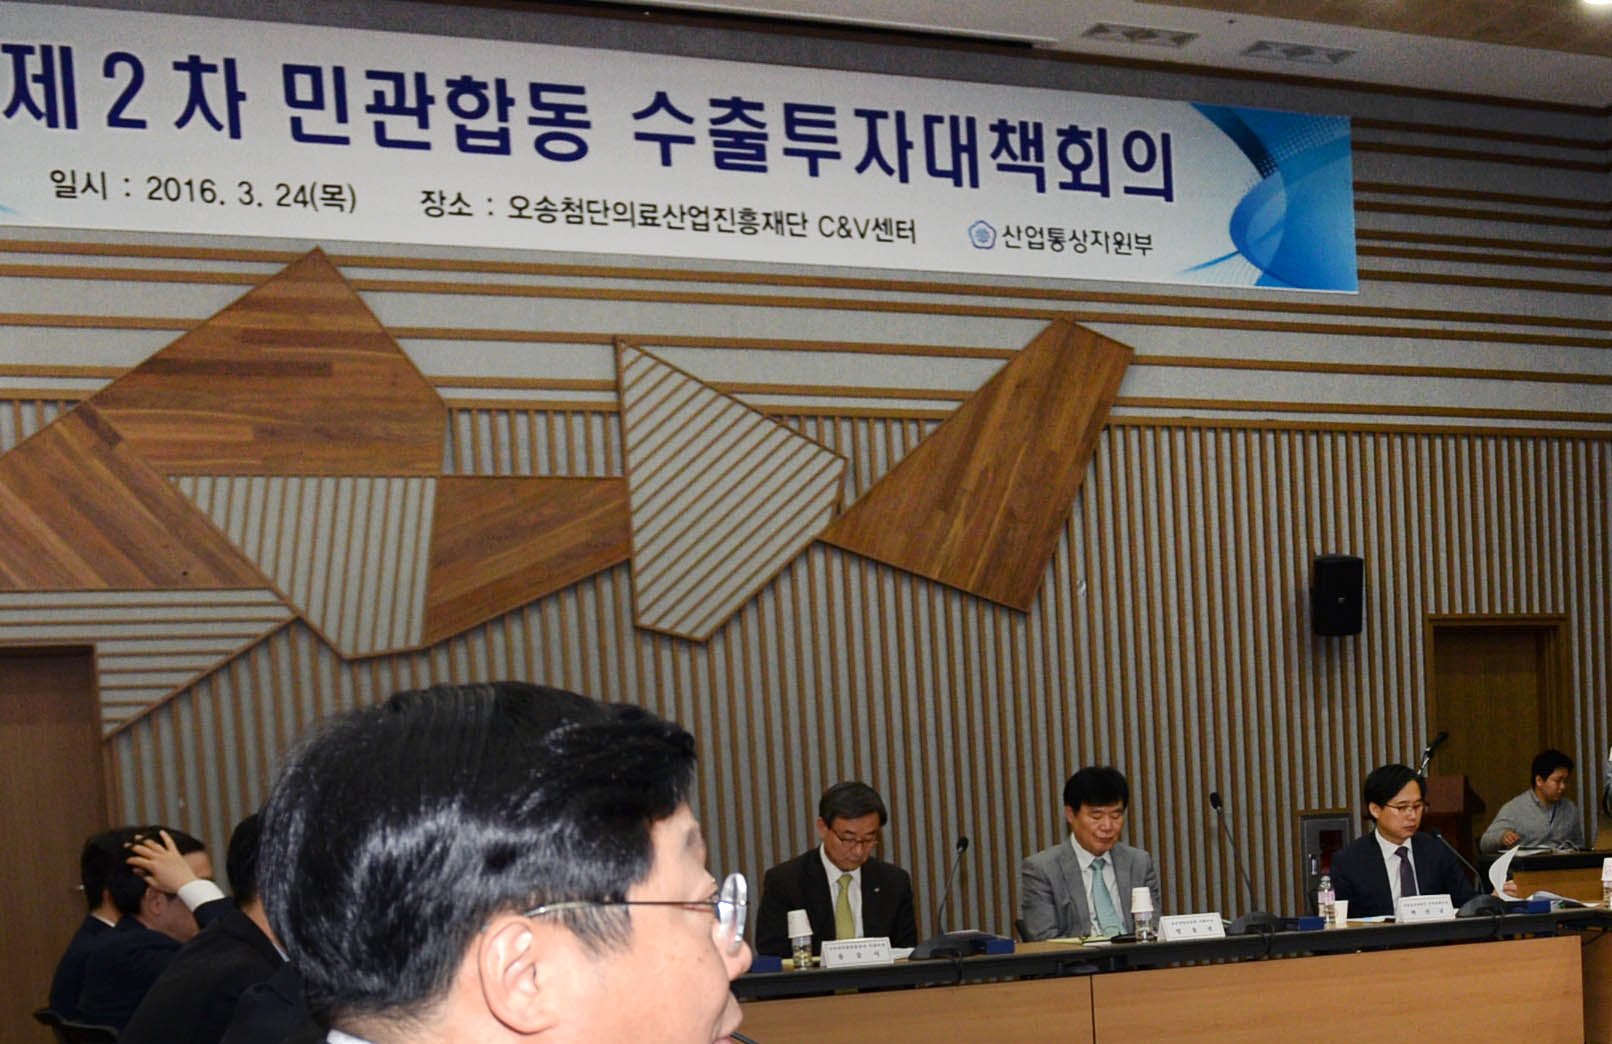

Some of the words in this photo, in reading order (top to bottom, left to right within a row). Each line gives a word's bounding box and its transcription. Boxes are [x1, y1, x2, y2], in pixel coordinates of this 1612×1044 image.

[281, 63, 592, 162] 민관합동
[631, 91, 1175, 203] 수출투자대책회의
[50, 169, 107, 200] 일시
[146, 175, 226, 206] 2016.
[238, 180, 263, 208] 3.
[275, 181, 357, 214] 24(목)
[420, 189, 474, 218] 장소
[508, 195, 808, 237] 오송첨단의료산업진흥재단
[818, 215, 917, 244] C&V센터
[1002, 225, 1154, 256] 산업통상자원부
